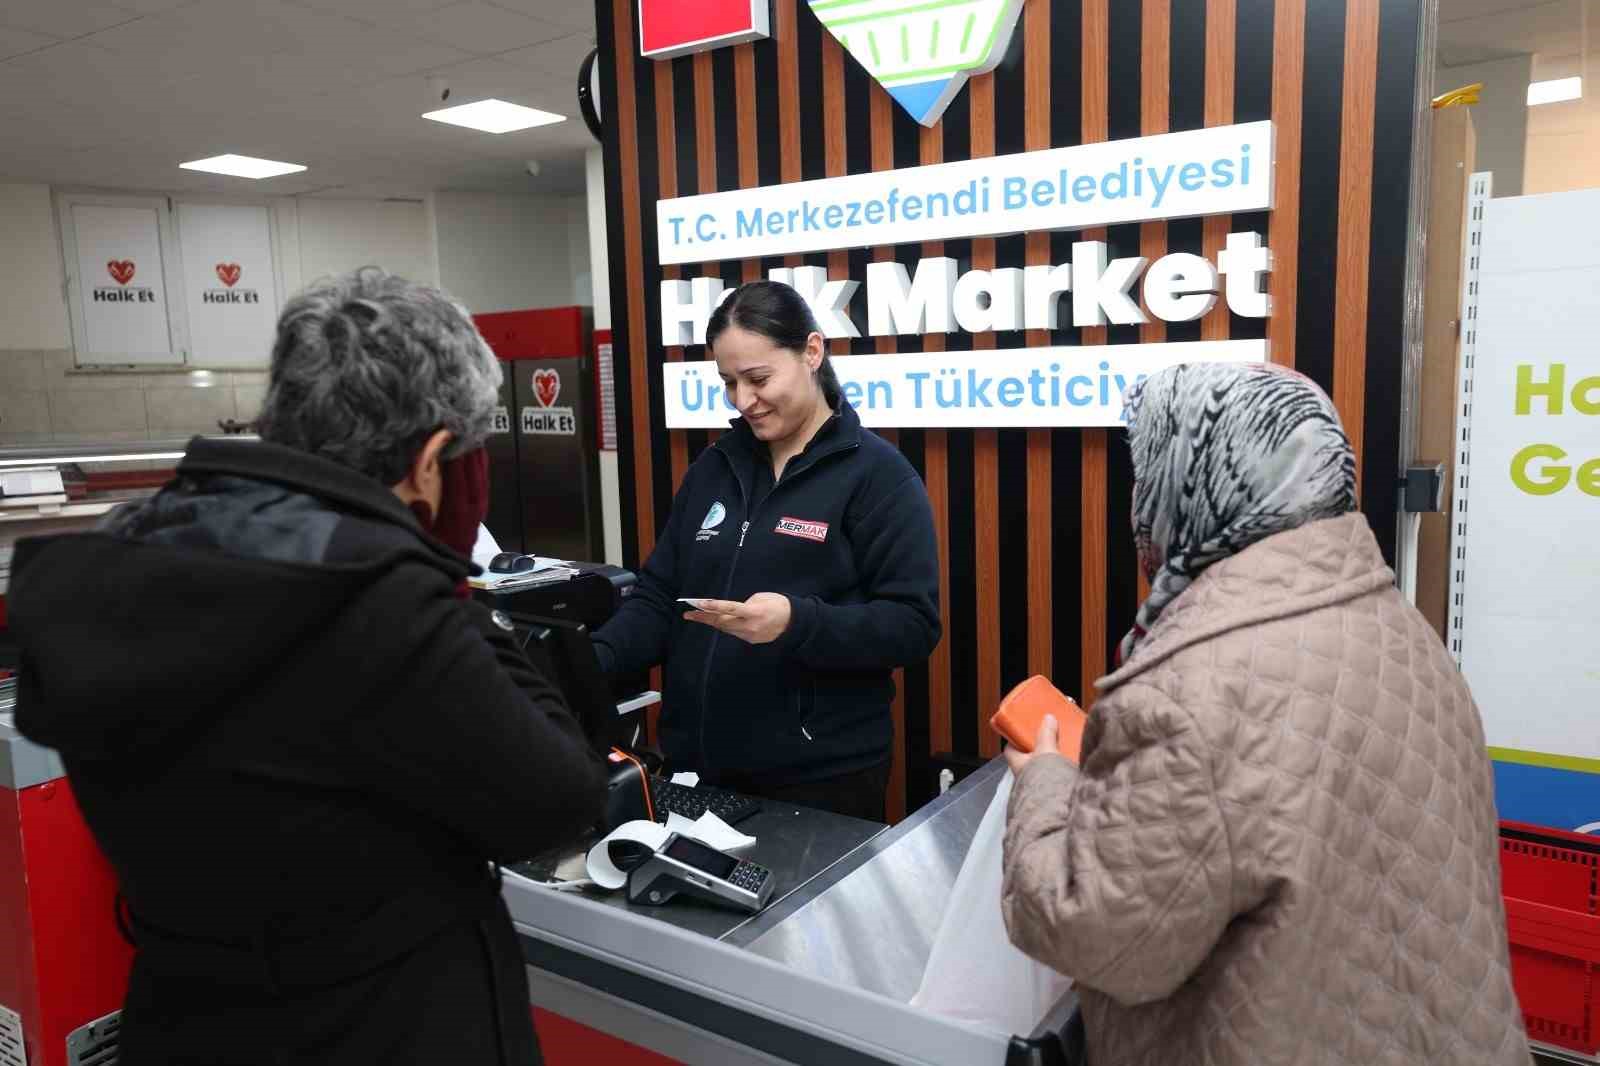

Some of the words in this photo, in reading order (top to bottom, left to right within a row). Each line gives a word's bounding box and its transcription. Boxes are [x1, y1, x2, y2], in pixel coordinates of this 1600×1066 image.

[669, 214, 726, 245] T.C.
[736, 176, 989, 239] Merkezefendi
[1003, 143, 1251, 210] Belediyesi
[866, 231, 1272, 337] Market
[93, 289, 134, 303] Halk
[138, 289, 155, 303] Et
[203, 291, 240, 304] Halk
[244, 291, 259, 304] Et
[524, 415, 557, 432] Halk
[559, 416, 575, 433] Et
[777, 519, 826, 538] MERMAK
